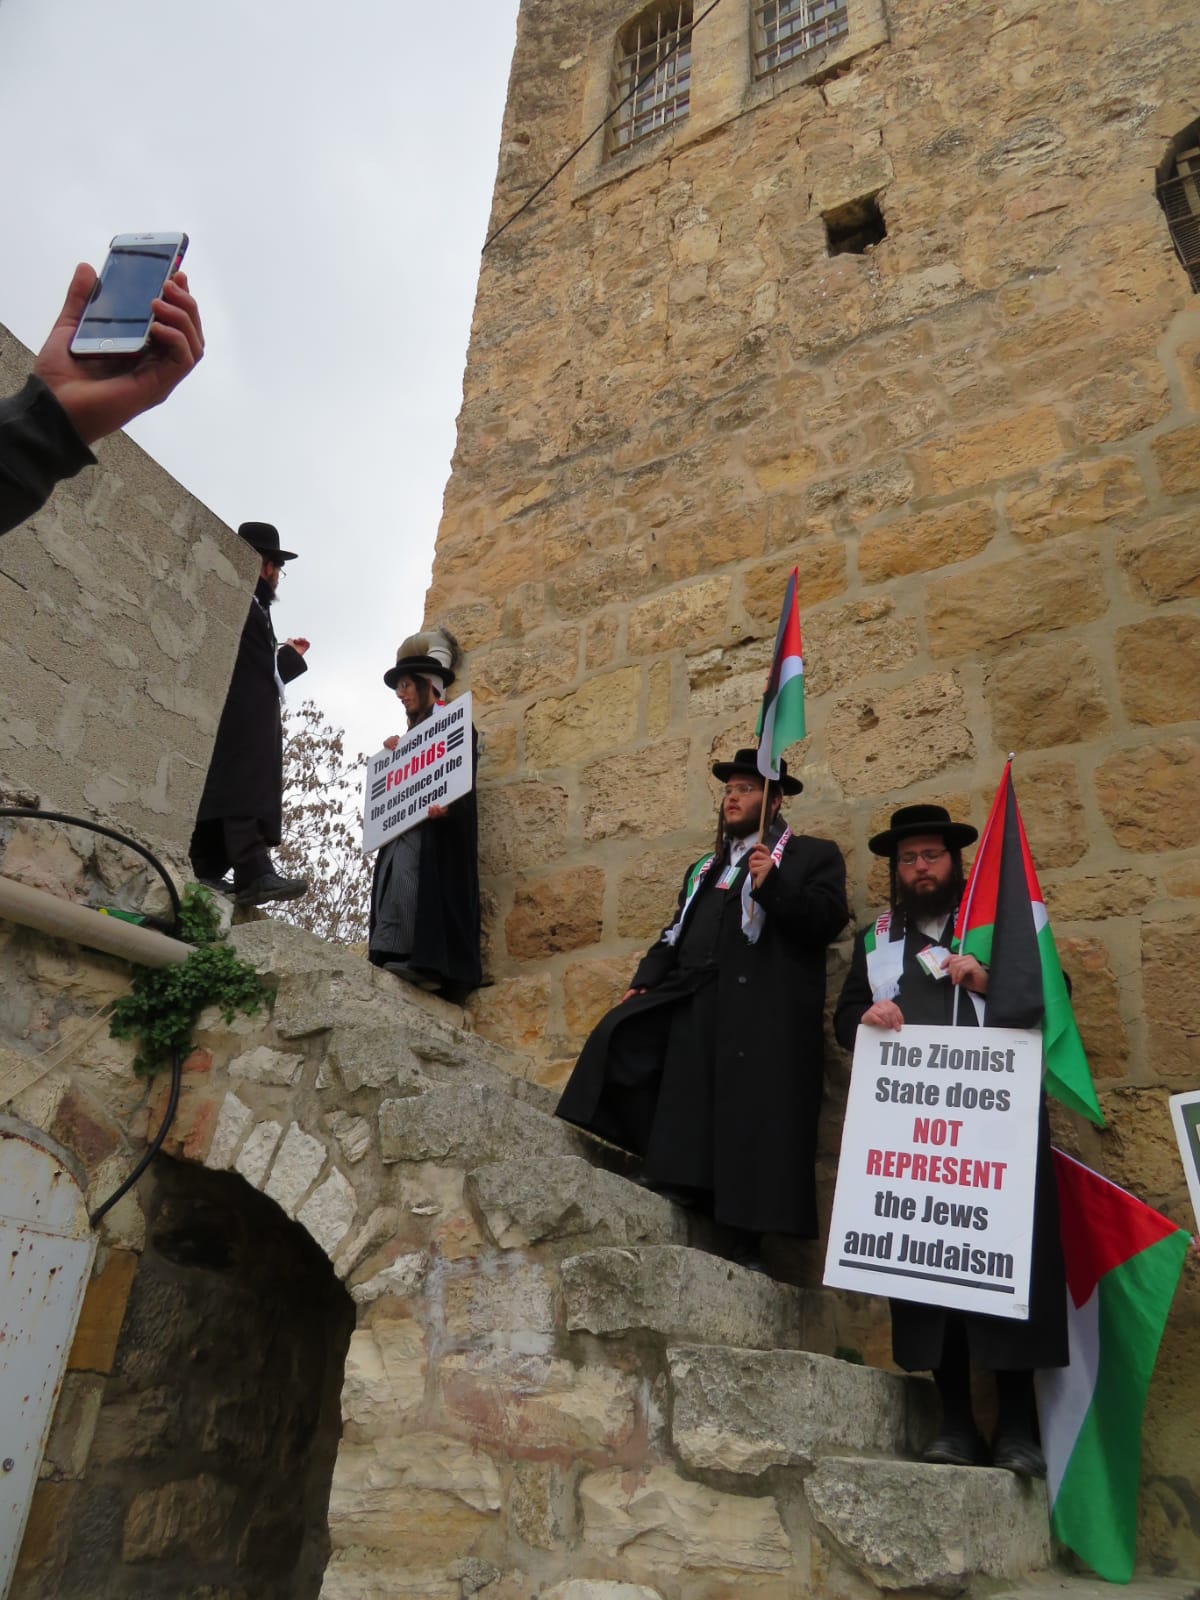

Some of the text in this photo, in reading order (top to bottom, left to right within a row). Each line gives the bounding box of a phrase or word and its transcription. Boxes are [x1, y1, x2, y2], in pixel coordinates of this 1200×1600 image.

[374, 707, 464, 775] The Jewish religion
[371, 755, 462, 821] the existence of the
[386, 740, 446, 792] Forbids
[382, 780, 447, 832] state of Israel
[879, 1041, 1015, 1073] The Zionist
[875, 1077, 1011, 1112] State does
[912, 1117, 963, 1147] NOT
[865, 1149, 1007, 1190] REPRESENT
[874, 1190, 989, 1231] the Jews
[843, 1230, 1014, 1279] and Judaism
